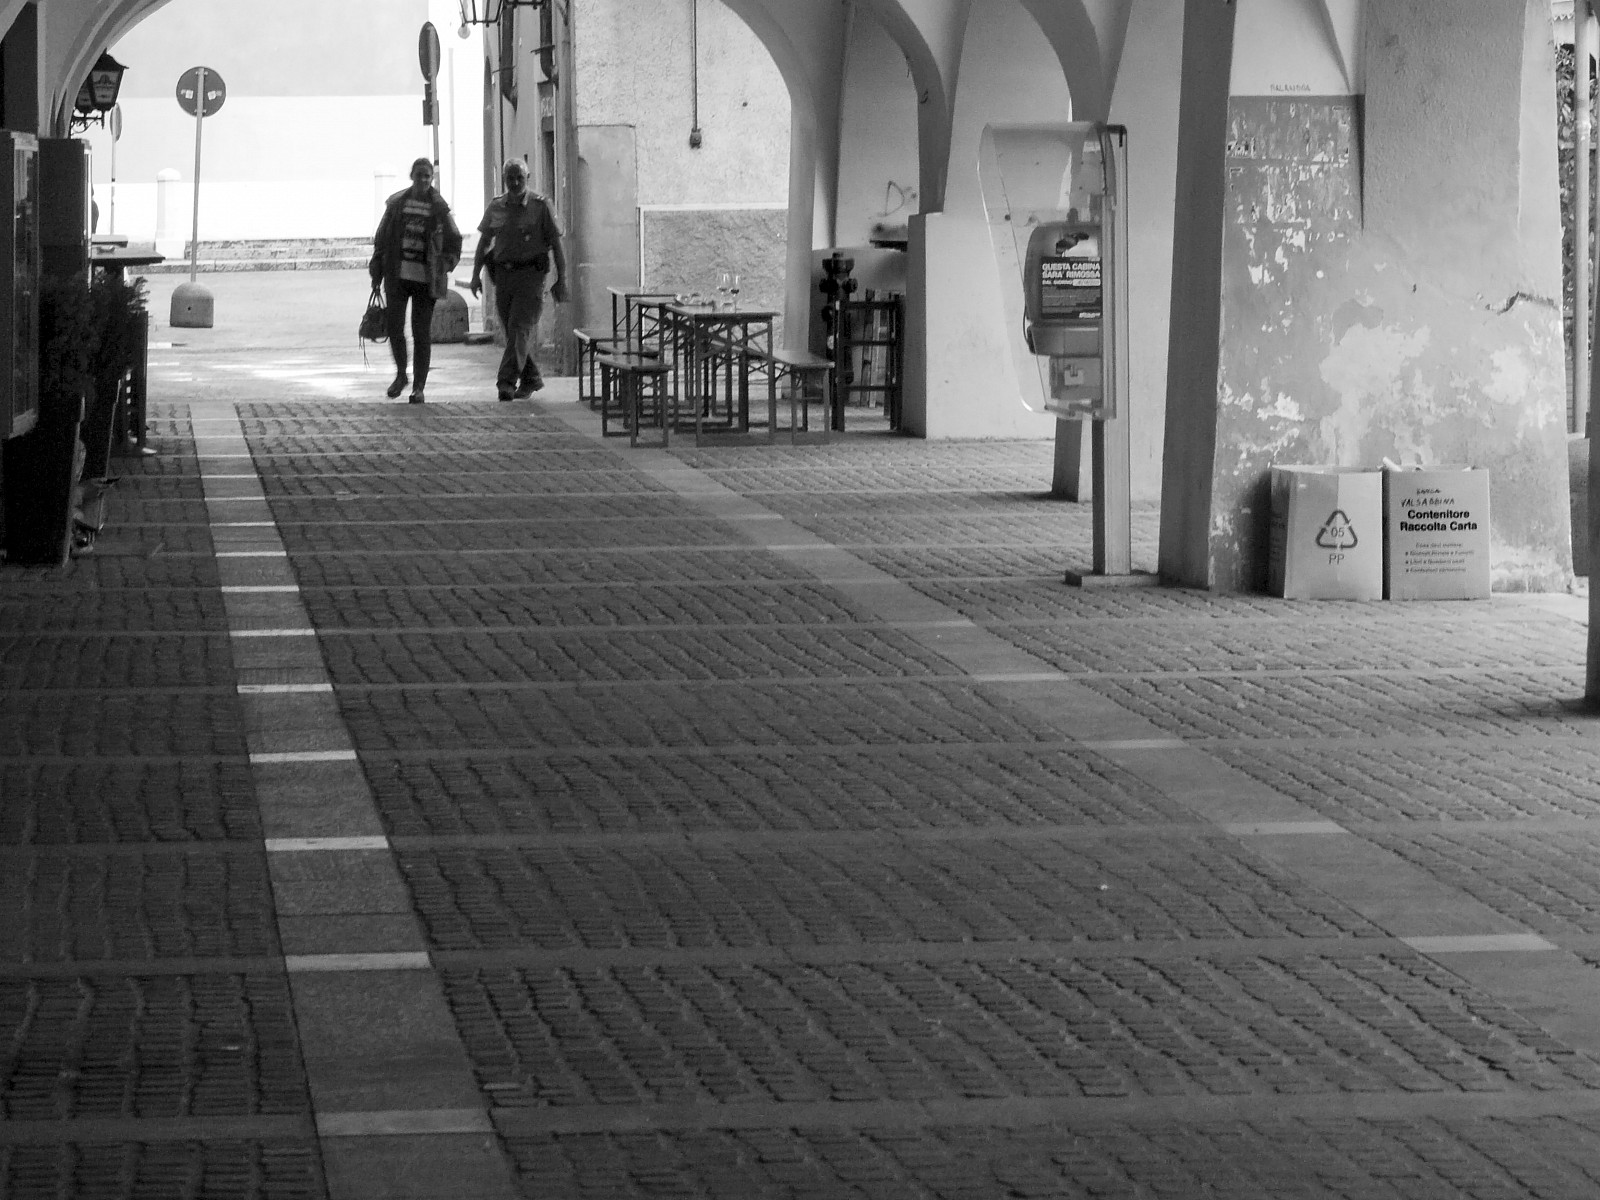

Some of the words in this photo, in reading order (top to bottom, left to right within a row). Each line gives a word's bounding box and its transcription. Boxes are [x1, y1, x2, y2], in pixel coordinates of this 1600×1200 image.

[1042, 263, 1071, 271] QUESTA
[1072, 263, 1100, 271] CABINA
[1407, 509, 1470, 519] Contenitore
[1400, 521, 1447, 531] Raccolta
[1449, 521, 1477, 531] Carta
[1330, 527, 1345, 538] 05
[1328, 554, 1345, 565] PP
